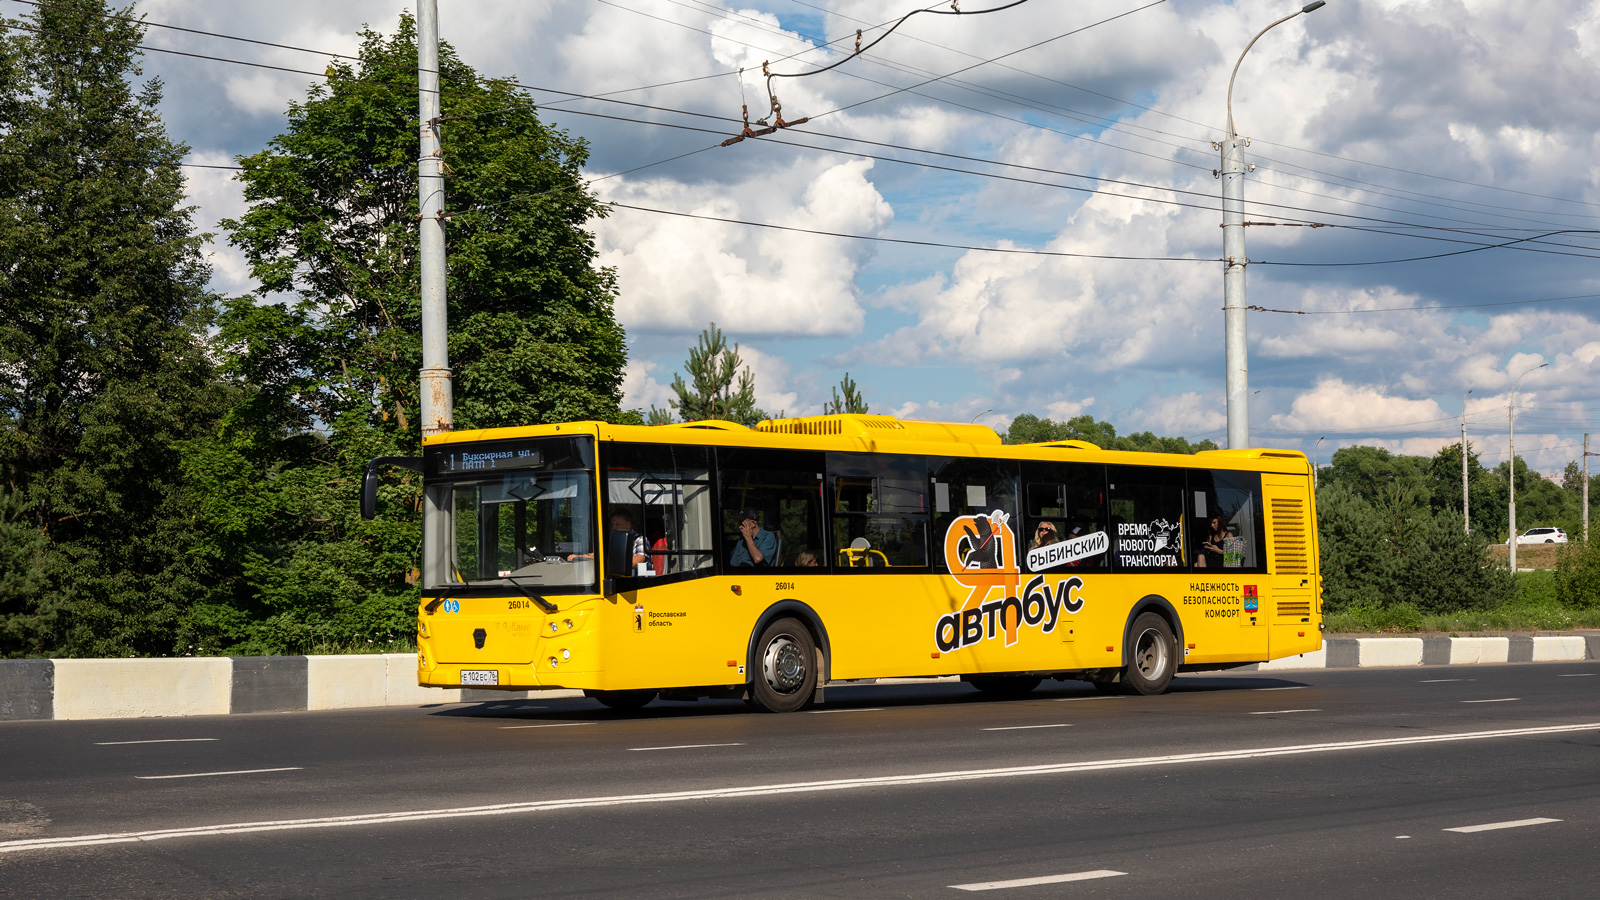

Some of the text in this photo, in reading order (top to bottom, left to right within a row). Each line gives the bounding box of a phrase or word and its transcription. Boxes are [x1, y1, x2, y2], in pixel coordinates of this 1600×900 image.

[462, 449, 535, 461] Буксирная ул.
[490, 459, 496, 468] 1
[1118, 523, 1148, 536] ВРЕМЯ
[1119, 539, 1154, 551] НОВОГО
[1030, 533, 1105, 569] РЫБИНСКИЙ
[1120, 555, 1178, 567] ТРАНСПОРТА
[775, 582, 795, 590] 26014
[1189, 582, 1240, 593] НАДЕЖНОСТЬ
[508, 601, 530, 609] 26014
[1183, 596, 1240, 605] БЕЗОПАСНОСТЬ
[648, 611, 687, 619] Ярославская
[936, 575, 1084, 653] автобус
[1204, 609, 1240, 618] КОМФОРТ
